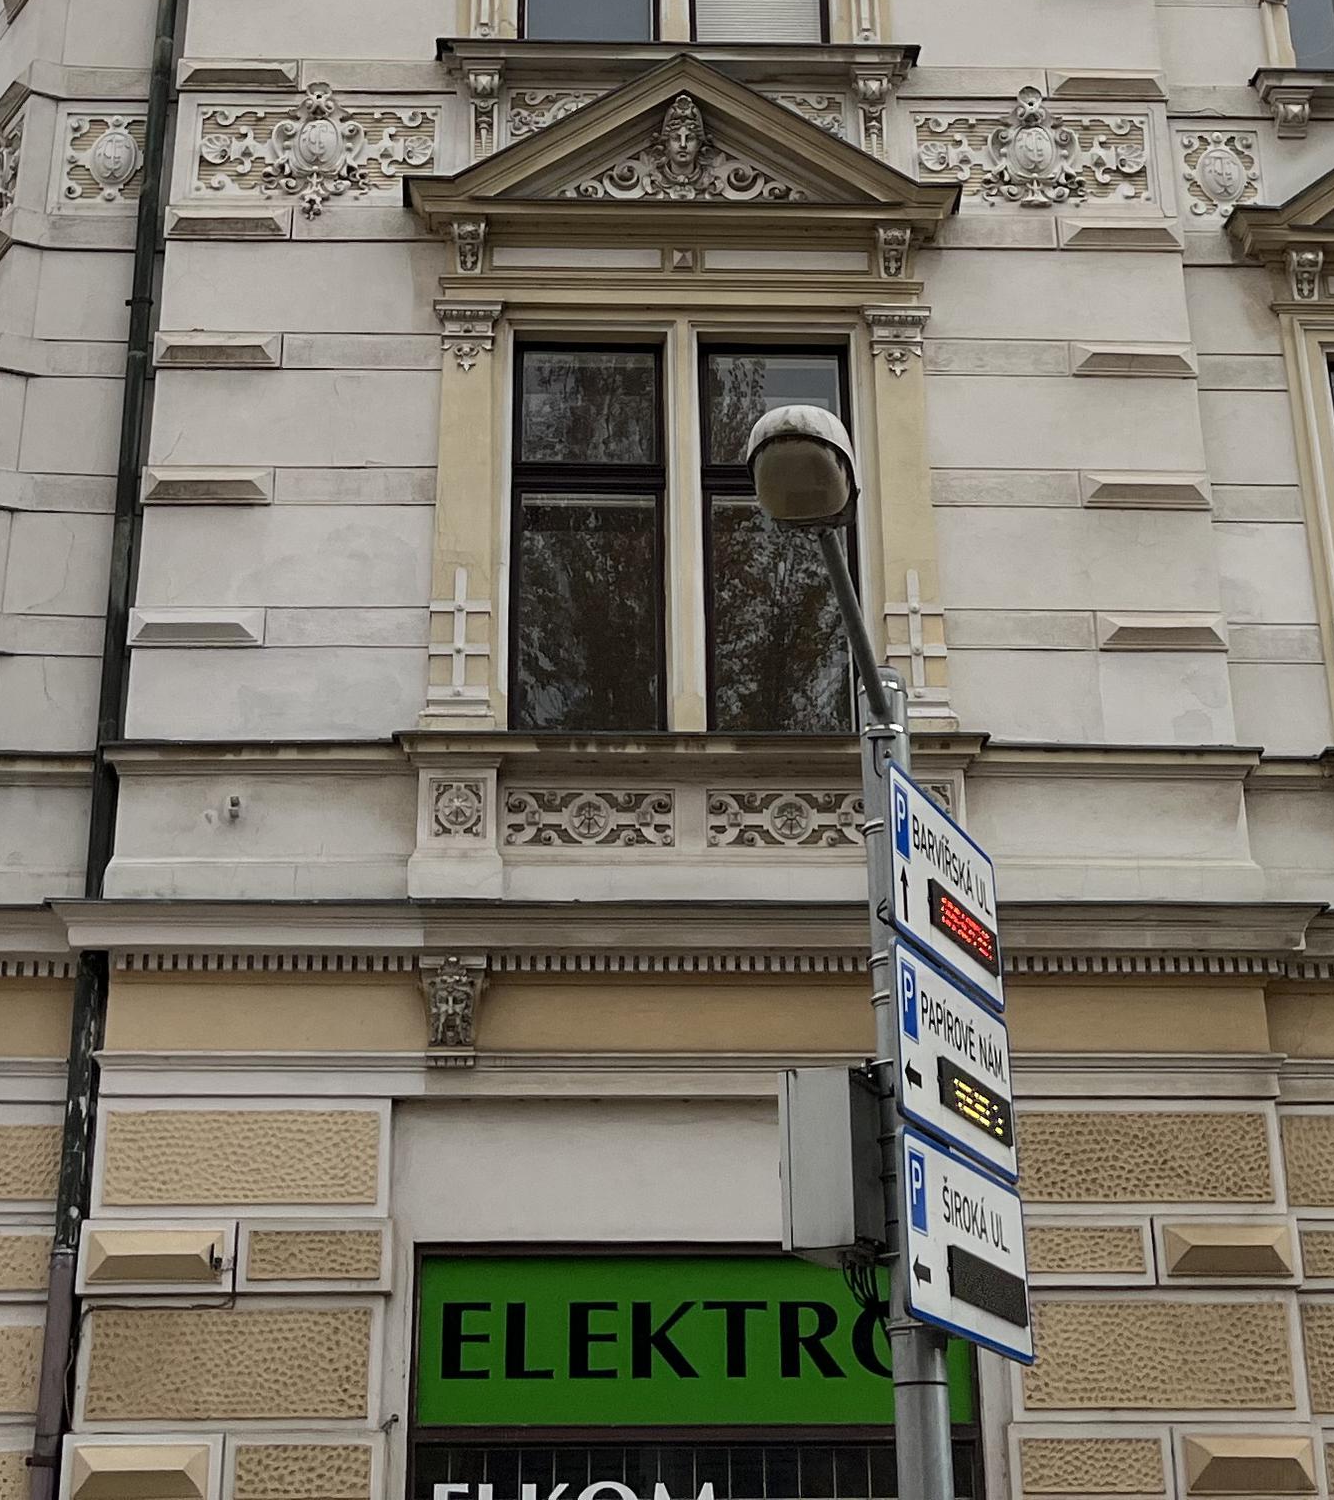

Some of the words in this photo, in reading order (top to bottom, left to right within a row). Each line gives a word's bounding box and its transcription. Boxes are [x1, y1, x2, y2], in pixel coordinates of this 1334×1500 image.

[896, 792, 906, 833] P
[912, 813, 974, 901] BARVÍŘSKÁ
[903, 969, 914, 1013] P
[920, 990, 976, 1062] PAPÍROVÉ
[978, 1033, 1006, 1084] NÁM.
[911, 1159, 922, 1205] P
[942, 1175, 988, 1243] ŠIROKÁ
[990, 1211, 1010, 1254] UL.
